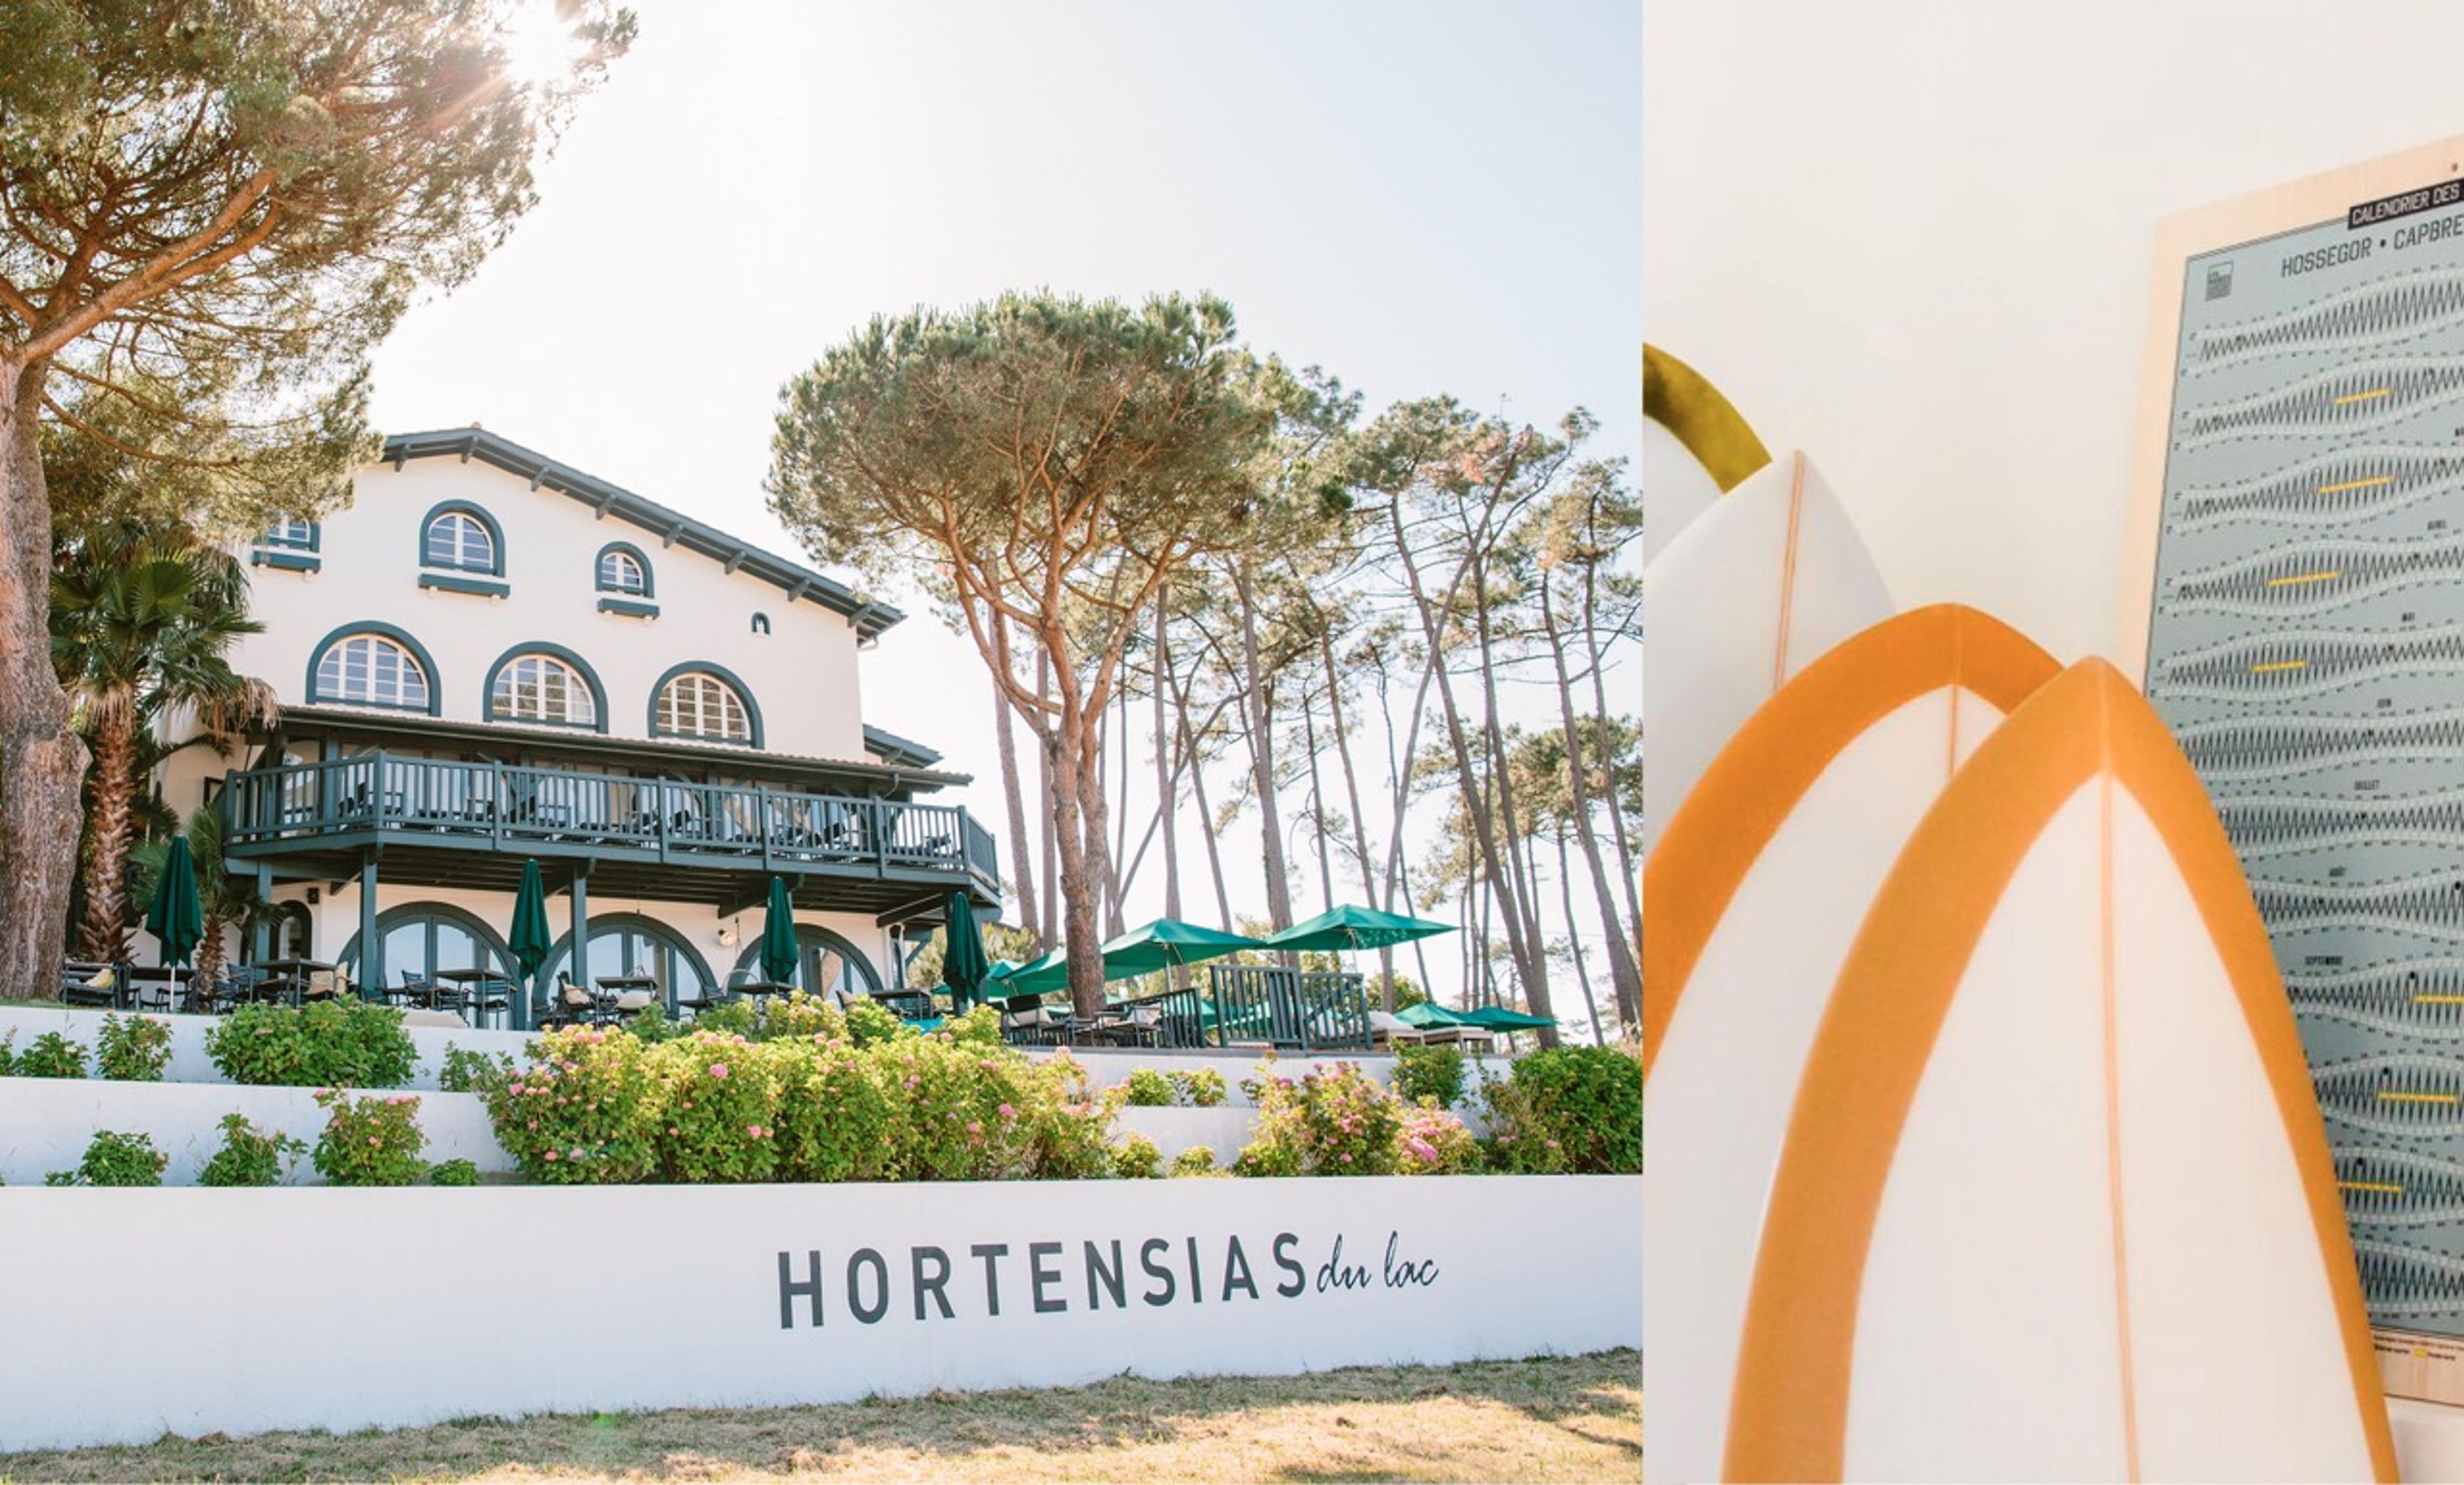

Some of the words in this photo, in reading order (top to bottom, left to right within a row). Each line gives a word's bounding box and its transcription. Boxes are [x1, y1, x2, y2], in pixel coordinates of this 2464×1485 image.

[2352, 191, 2429, 225] CALENDRIER
[2433, 183, 2460, 205] DES
[2281, 237, 2372, 278] HOSSEGOR
[778, 1233, 1306, 1329] HORTENSIAS
[1317, 1233, 1371, 1293] du
[1384, 1230, 1439, 1288] lac
